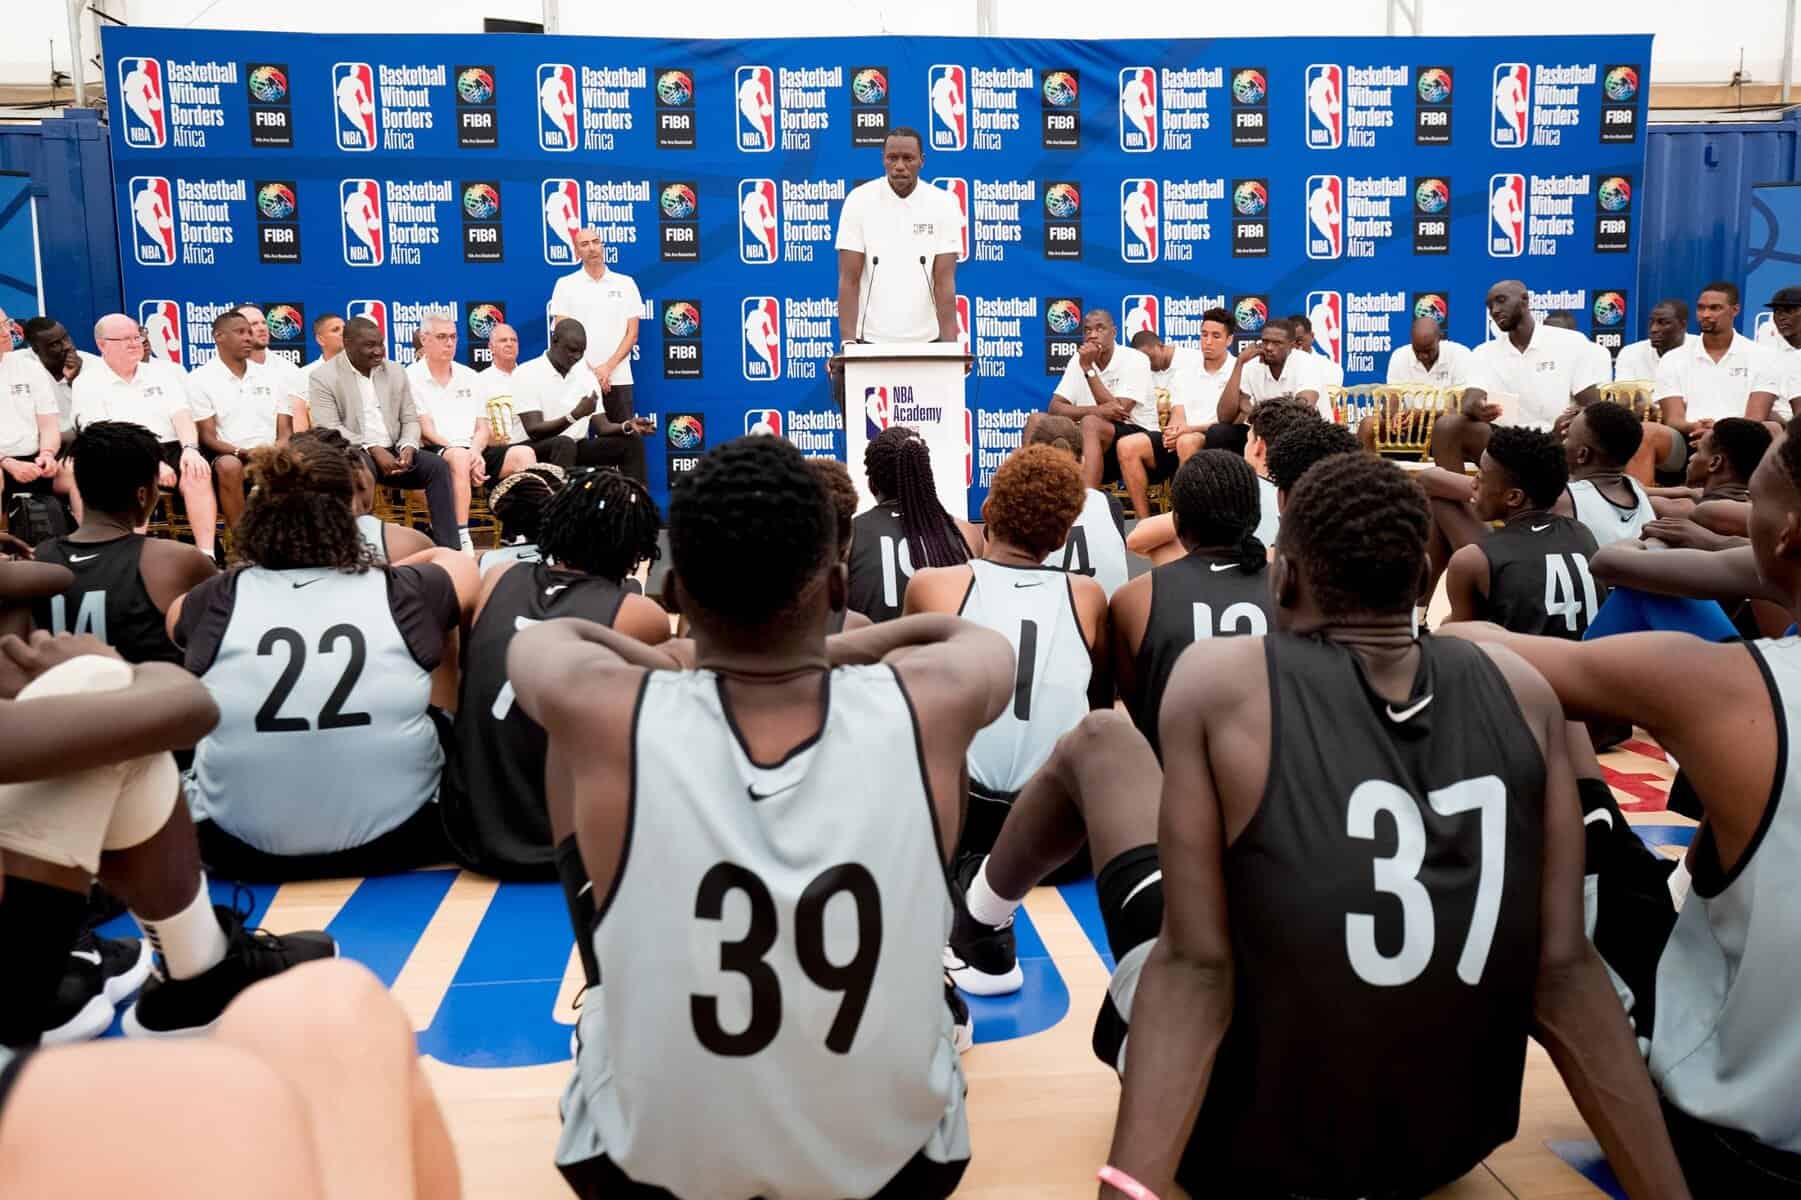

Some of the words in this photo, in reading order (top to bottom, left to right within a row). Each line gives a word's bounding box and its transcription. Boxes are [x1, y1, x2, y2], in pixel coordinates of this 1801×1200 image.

[166, 60, 238, 84] Basketball
[378, 64, 446, 86] Basketball
[582, 67, 646, 88] Basketball
[779, 67, 842, 87] Basketball
[971, 67, 1033, 88] Basketball
[1161, 67, 1223, 88] Basketball
[1347, 65, 1408, 86] Basketball
[1535, 64, 1597, 85] Basketball
[168, 82, 221, 105] Without
[380, 85, 430, 107] Without
[582, 88, 630, 108] Without
[779, 87, 826, 108] Without
[971, 88, 1017, 109] Without
[1162, 88, 1208, 109] Without
[1347, 86, 1392, 107] Without
[1534, 84, 1579, 105] Without
[171, 104, 224, 127] Borders
[256, 112, 286, 128] FIBA
[382, 107, 432, 129] Borders
[463, 113, 492, 128] FIBA
[583, 108, 633, 130] Borders
[662, 115, 690, 130] FIBA
[780, 108, 829, 129] Borders
[857, 113, 884, 128] FIBA
[972, 109, 1020, 130] Borders
[1048, 115, 1075, 130] FIBA
[1162, 109, 1210, 130] Borders
[1236, 113, 1263, 128] FIBA
[1347, 106, 1393, 127] Borders
[1420, 112, 1447, 126] FIBA
[1533, 105, 1579, 126] Borders
[1605, 110, 1632, 124] FIBA
[130, 126, 152, 143] NBA
[172, 126, 206, 148] Africa
[342, 130, 362, 145] NBA
[383, 128, 414, 150] Africa
[545, 131, 563, 146] NBA
[584, 129, 614, 150] Africa
[743, 131, 761, 146] NBA
[781, 128, 811, 150] Africa
[935, 131, 953, 145] NBA
[972, 129, 1001, 150] Africa
[1126, 133, 1144, 147] NBA
[1162, 129, 1192, 150] Africa
[1347, 126, 1375, 148] Africa
[1532, 125, 1561, 146] Africa
[177, 179, 246, 200] Basketball
[386, 181, 452, 201] Basketball
[585, 180, 650, 201] Basketball
[782, 180, 845, 201] Basketball
[974, 180, 1035, 201] Basketball
[1163, 179, 1224, 200] Basketball
[1347, 176, 1407, 197] Basketball
[1530, 175, 1590, 195] Basketball
[179, 200, 229, 222] Without
[387, 202, 436, 222] Without
[586, 201, 634, 222] Without
[782, 200, 829, 221] Without
[974, 200, 1020, 221] Without
[1163, 200, 1209, 220] Without
[1347, 196, 1390, 217] Without
[1530, 195, 1573, 215] Without
[181, 222, 233, 243] Borders
[264, 228, 294, 243] FIBA
[389, 223, 439, 244] Borders
[469, 228, 497, 242] FIBA
[665, 228, 693, 242] FIBA
[783, 221, 831, 242] Borders
[975, 221, 1022, 241] Borders
[1050, 227, 1076, 241] FIBA
[1164, 220, 1210, 241] Borders
[1238, 225, 1264, 238] FIBA
[1346, 216, 1392, 237] Borders
[1419, 222, 1445, 235] FIBA
[1529, 215, 1574, 236] Borders
[1600, 220, 1626, 234] FIBA
[141, 244, 161, 260] NBA
[183, 242, 214, 265] Africa
[350, 246, 369, 261] NBA
[390, 243, 421, 265] Africa
[550, 244, 568, 260] NBA
[746, 244, 764, 259] NBA
[784, 241, 813, 262] Africa
[975, 240, 1004, 262] Africa
[1127, 243, 1145, 257] NBA
[1164, 240, 1193, 261] Africa
[1347, 236, 1375, 257] Africa
[1529, 235, 1557, 256] Africa
[785, 298, 839, 318] Basketba
[976, 297, 1037, 317] Basketball
[1347, 292, 1406, 312] Basketball
[1528, 289, 1585, 310] Basketball
[786, 318, 831, 338] Without
[976, 317, 1021, 337] Without
[1347, 312, 1390, 332] Without
[670, 346, 697, 360] FIBA
[786, 338, 834, 358] Borders
[976, 337, 1023, 357] Borders
[1347, 333, 1391, 352] Borders
[474, 348, 493, 362] FIB
[1347, 352, 1374, 372] Africa
[749, 362, 767, 375] NBA
[787, 358, 815, 379] Africa
[893, 386, 914, 404] NBA
[787, 410, 843, 430] Basketba
[893, 404, 942, 424] Academy
[978, 409, 1039, 428] Basketb
[978, 429, 1022, 448] Without
[1545, 553, 1599, 631] 41
[255, 623, 372, 733] 22
[1345, 775, 1507, 986] 37
[690, 861, 882, 1057] 39
